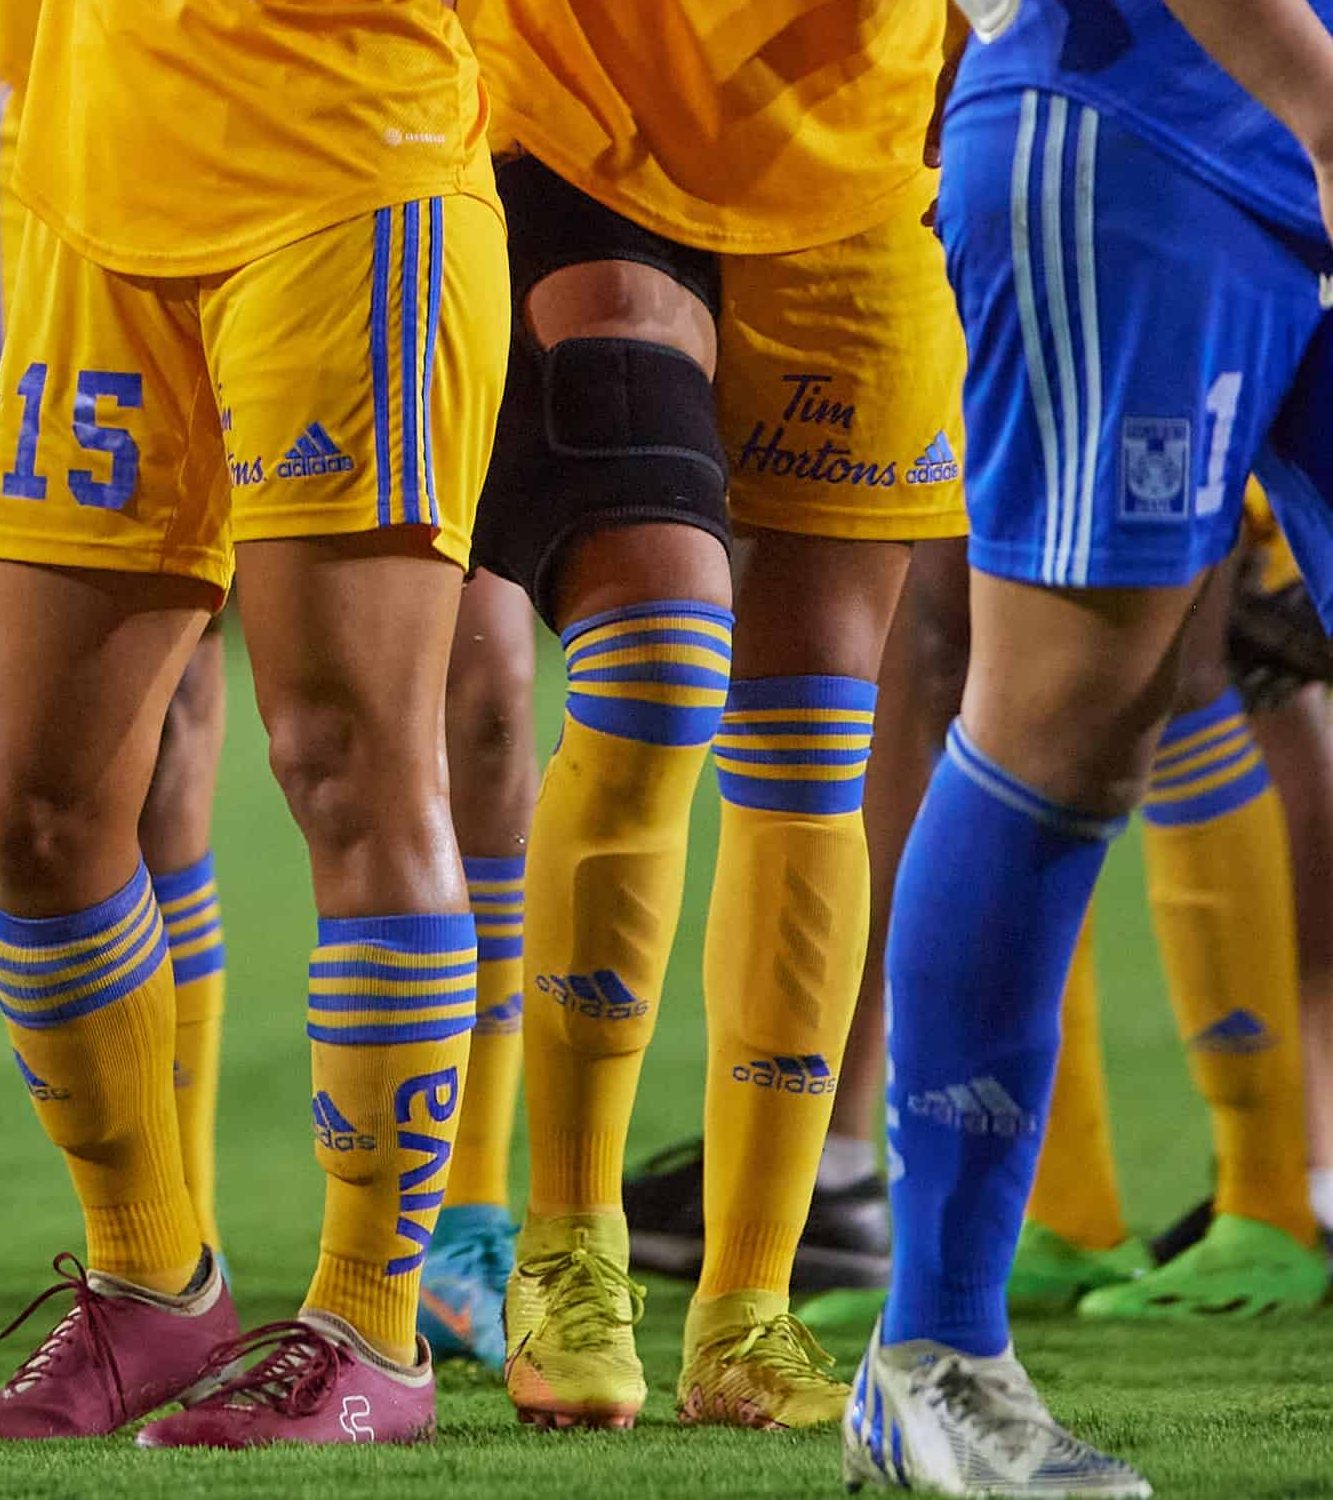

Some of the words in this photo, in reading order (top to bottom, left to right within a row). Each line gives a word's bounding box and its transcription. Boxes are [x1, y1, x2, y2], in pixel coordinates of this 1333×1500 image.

[782, 374, 857, 430] Tim
[2, 361, 143, 511] 15
[739, 419, 898, 488] Hortons
[1195, 372, 1243, 517] 1
[905, 460, 959, 485] adidas
[534, 974, 650, 1021] adidas
[732, 1065, 837, 1096] adidas
